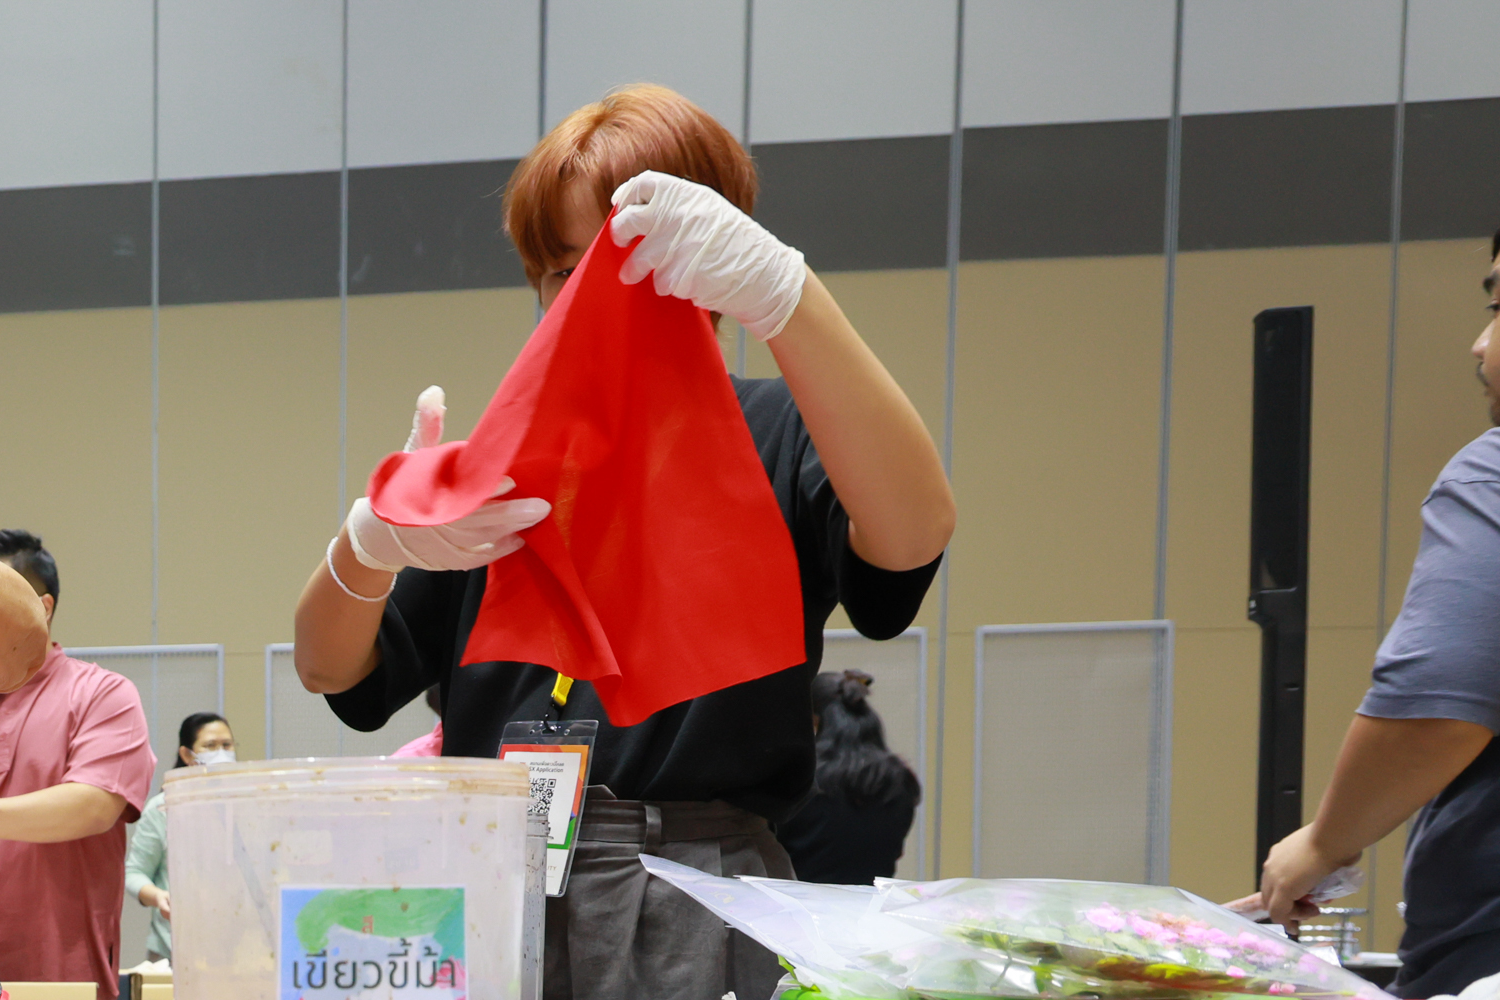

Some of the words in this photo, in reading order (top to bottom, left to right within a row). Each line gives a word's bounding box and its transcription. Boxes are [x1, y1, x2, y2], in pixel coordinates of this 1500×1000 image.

[293, 938, 456, 989] เขียวขี้ม้า
